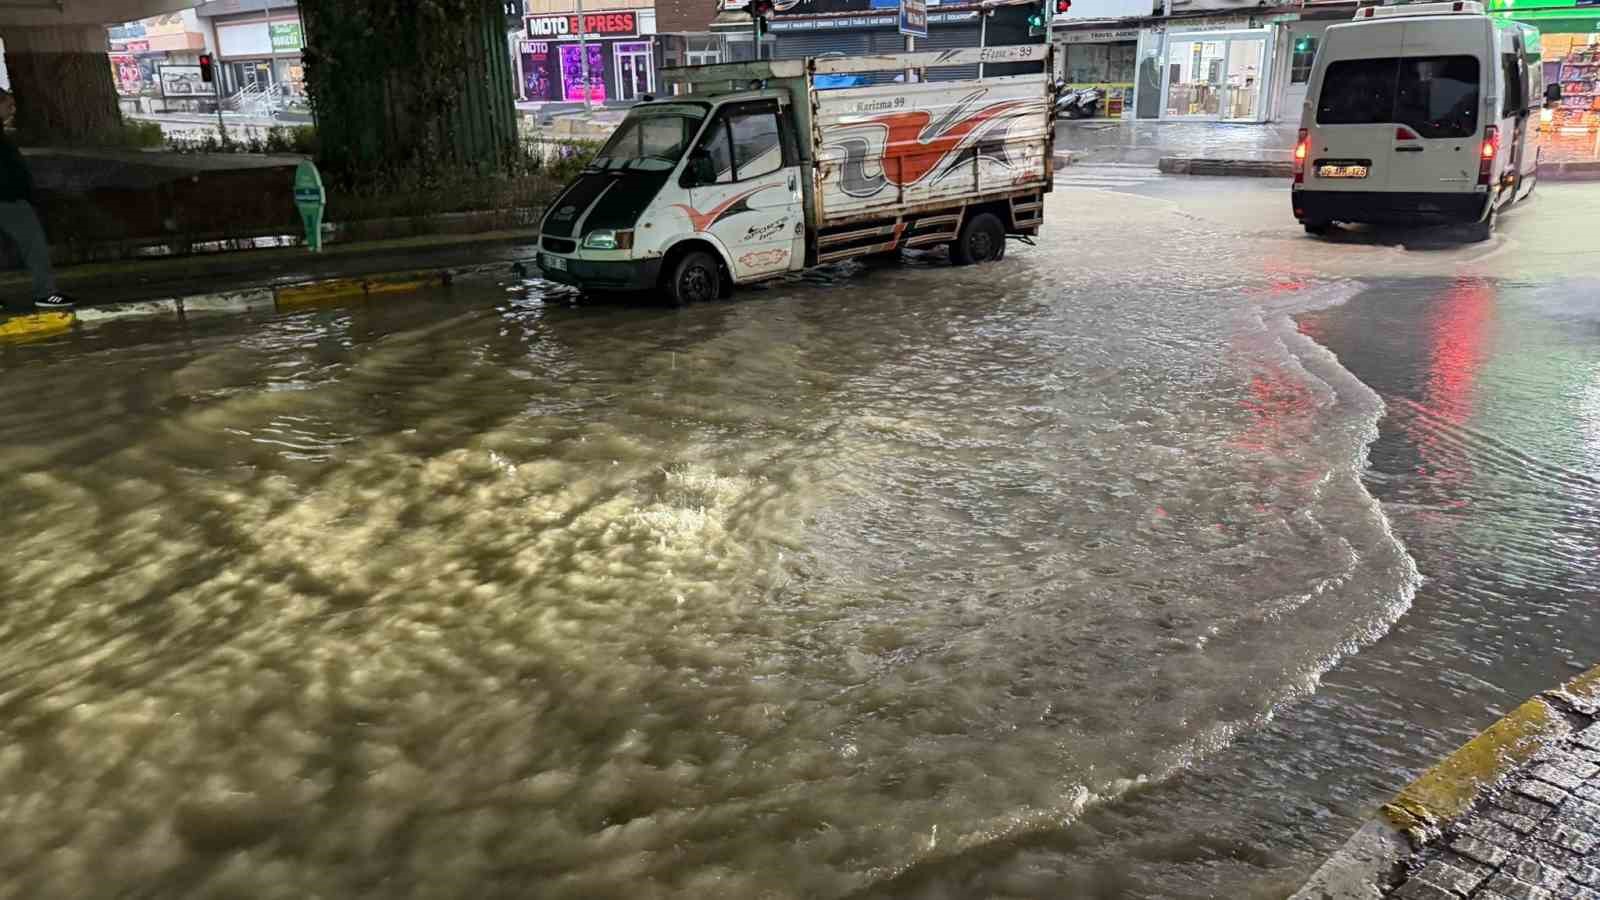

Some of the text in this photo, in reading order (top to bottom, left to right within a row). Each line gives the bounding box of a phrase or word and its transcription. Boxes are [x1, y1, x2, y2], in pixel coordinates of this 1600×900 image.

[530, 16, 568, 35] MOTO
[521, 42, 548, 54] MOTO
[1019, 46, 1032, 56] 99
[857, 97, 905, 112] Karizma 99
